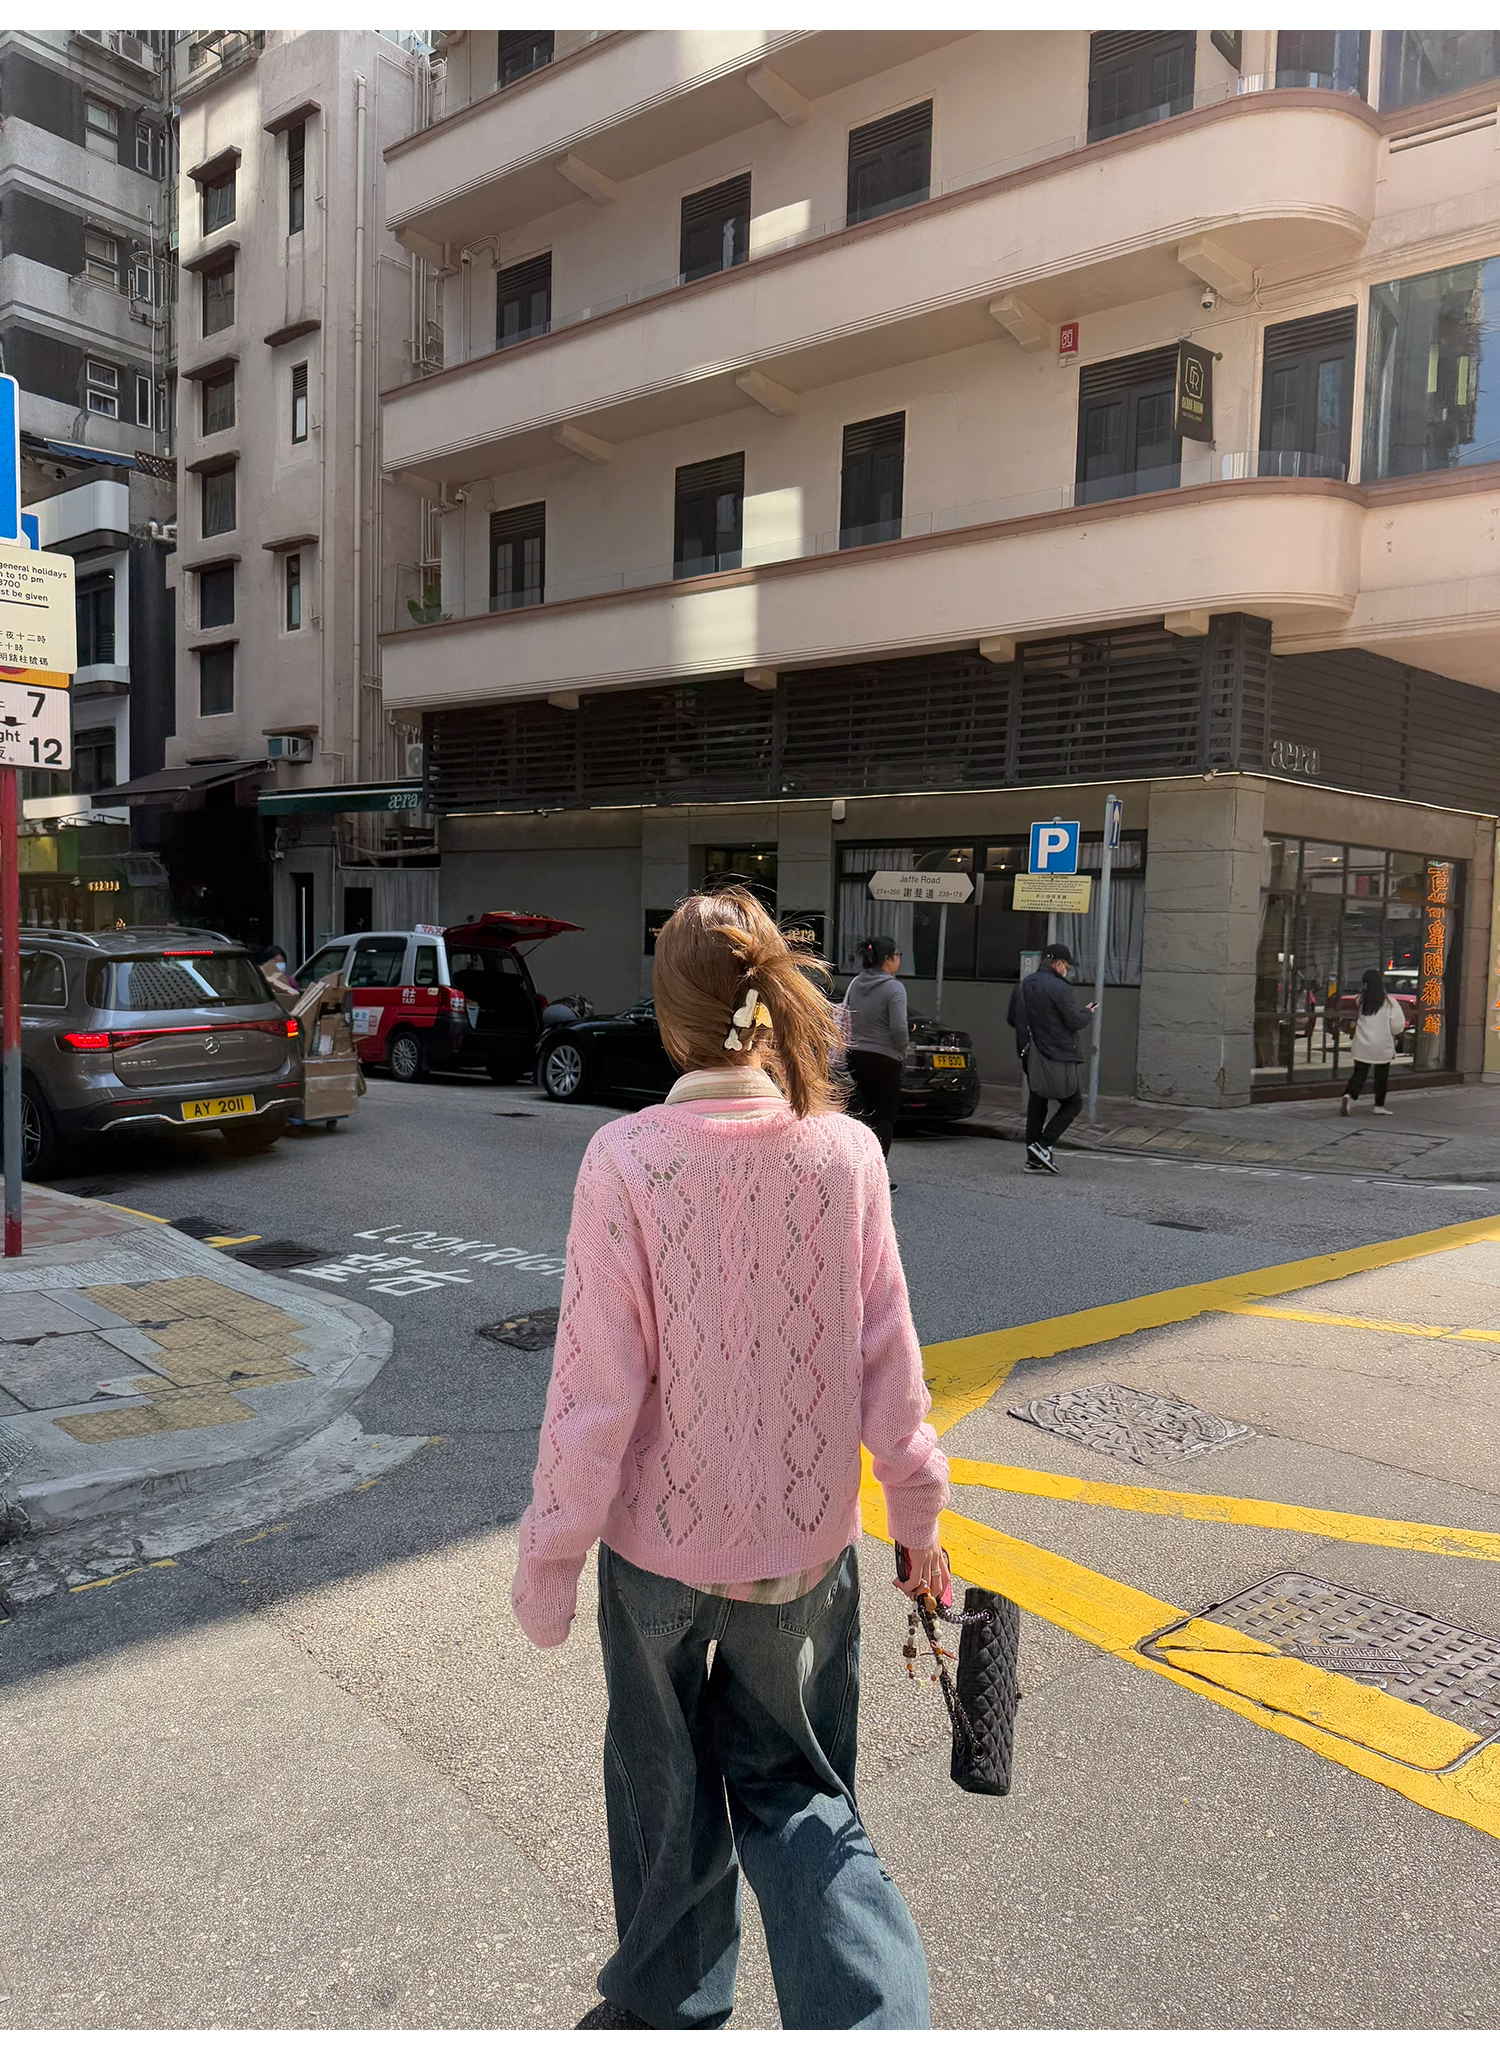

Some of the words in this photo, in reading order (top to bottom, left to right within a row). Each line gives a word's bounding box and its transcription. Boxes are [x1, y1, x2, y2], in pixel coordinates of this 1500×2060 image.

[6, 571, 15, 579] to
[18, 573, 28, 581] 10
[30, 576, 44, 584] pm
[32, 566, 67, 579] holidays
[12, 590, 22, 598] be
[25, 592, 48, 601] given
[27, 691, 46, 718] 7
[29, 737, 62, 765] 12
[1037, 828, 1069, 869] P
[900, 875, 919, 884] Jaffe
[921, 875, 941, 885] Road
[903, 887, 934, 899] 謝斐道
[195, 1102, 212, 1116] AY
[218, 1098, 245, 1113] 2011
[353, 1224, 497, 1257] LOOK
